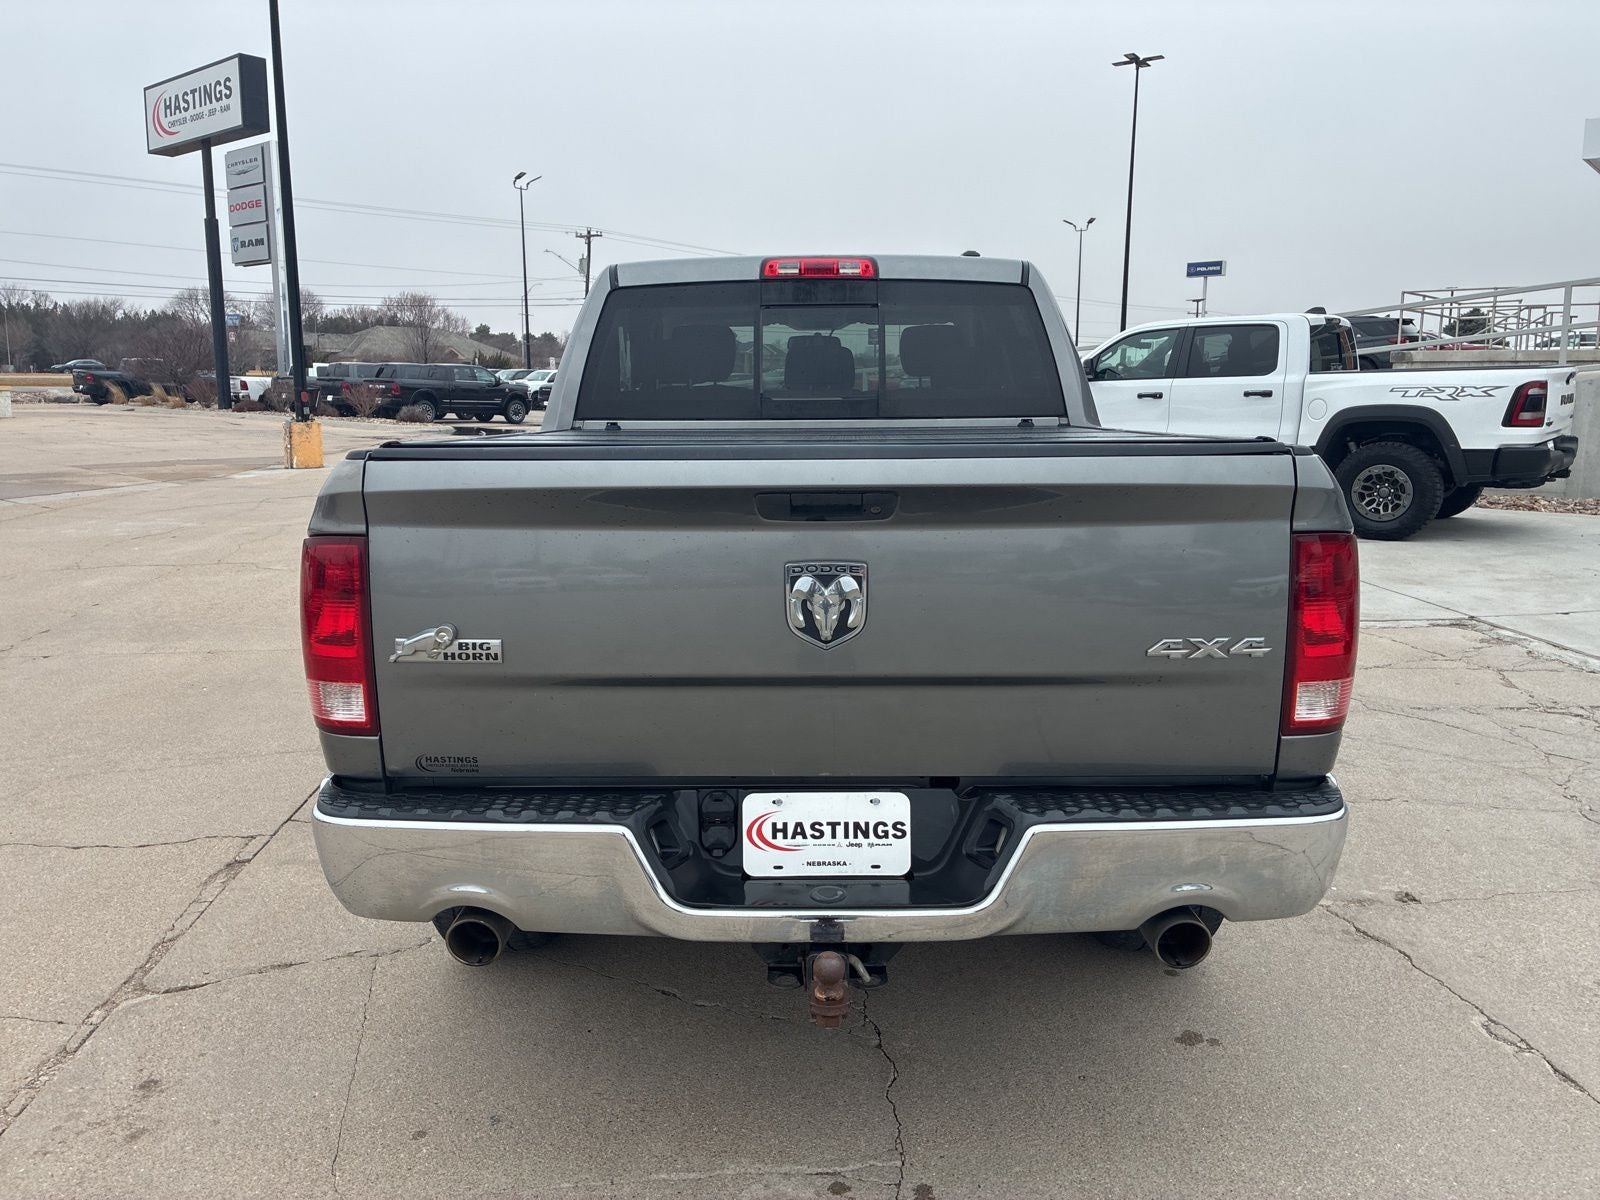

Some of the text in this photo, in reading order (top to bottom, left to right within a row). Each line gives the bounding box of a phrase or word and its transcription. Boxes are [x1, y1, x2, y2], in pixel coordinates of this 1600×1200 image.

[164, 77, 233, 118] HASTINGS
[227, 157, 258, 169] CHRYSLER
[229, 199, 262, 213] DODGE
[240, 238, 265, 249] RAM
[1389, 386, 1509, 401] TRX
[791, 565, 861, 574] DODGE
[457, 642, 492, 651] BIG
[443, 652, 499, 661] HORN
[425, 756, 478, 764] HASTINGS
[771, 821, 907, 840] HASTINGS
